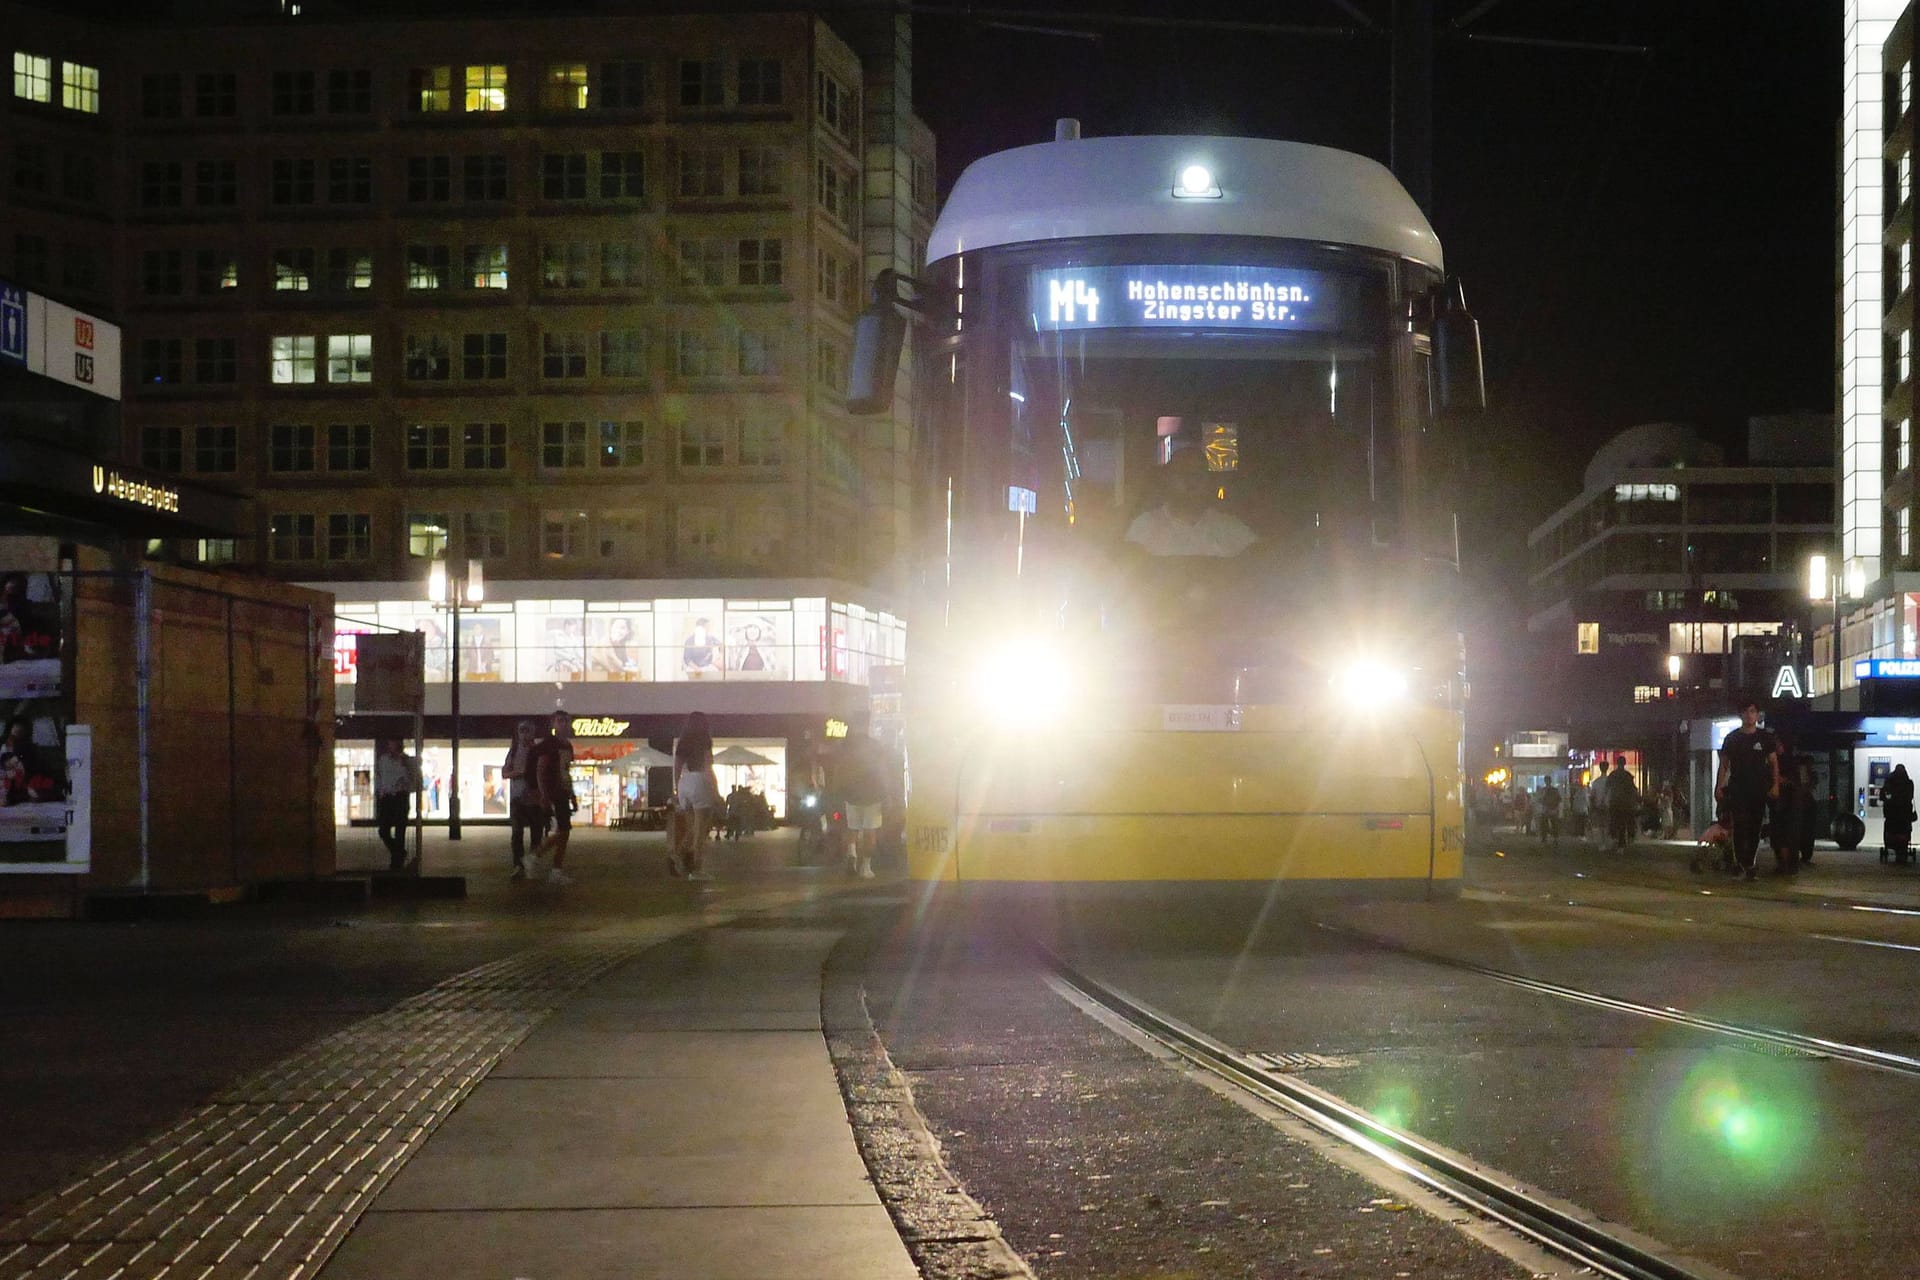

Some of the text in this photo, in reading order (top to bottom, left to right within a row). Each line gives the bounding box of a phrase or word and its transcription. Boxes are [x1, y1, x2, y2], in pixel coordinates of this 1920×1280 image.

[1048, 278, 1100, 323] M4
[1128, 280, 1311, 302] Hohenschönhsn.
[1143, 301, 1297, 322] Zingster Str.
[76, 319, 93, 348] U2
[76, 355, 93, 382] U5
[93, 464, 179, 513] U Alexanderplatz
